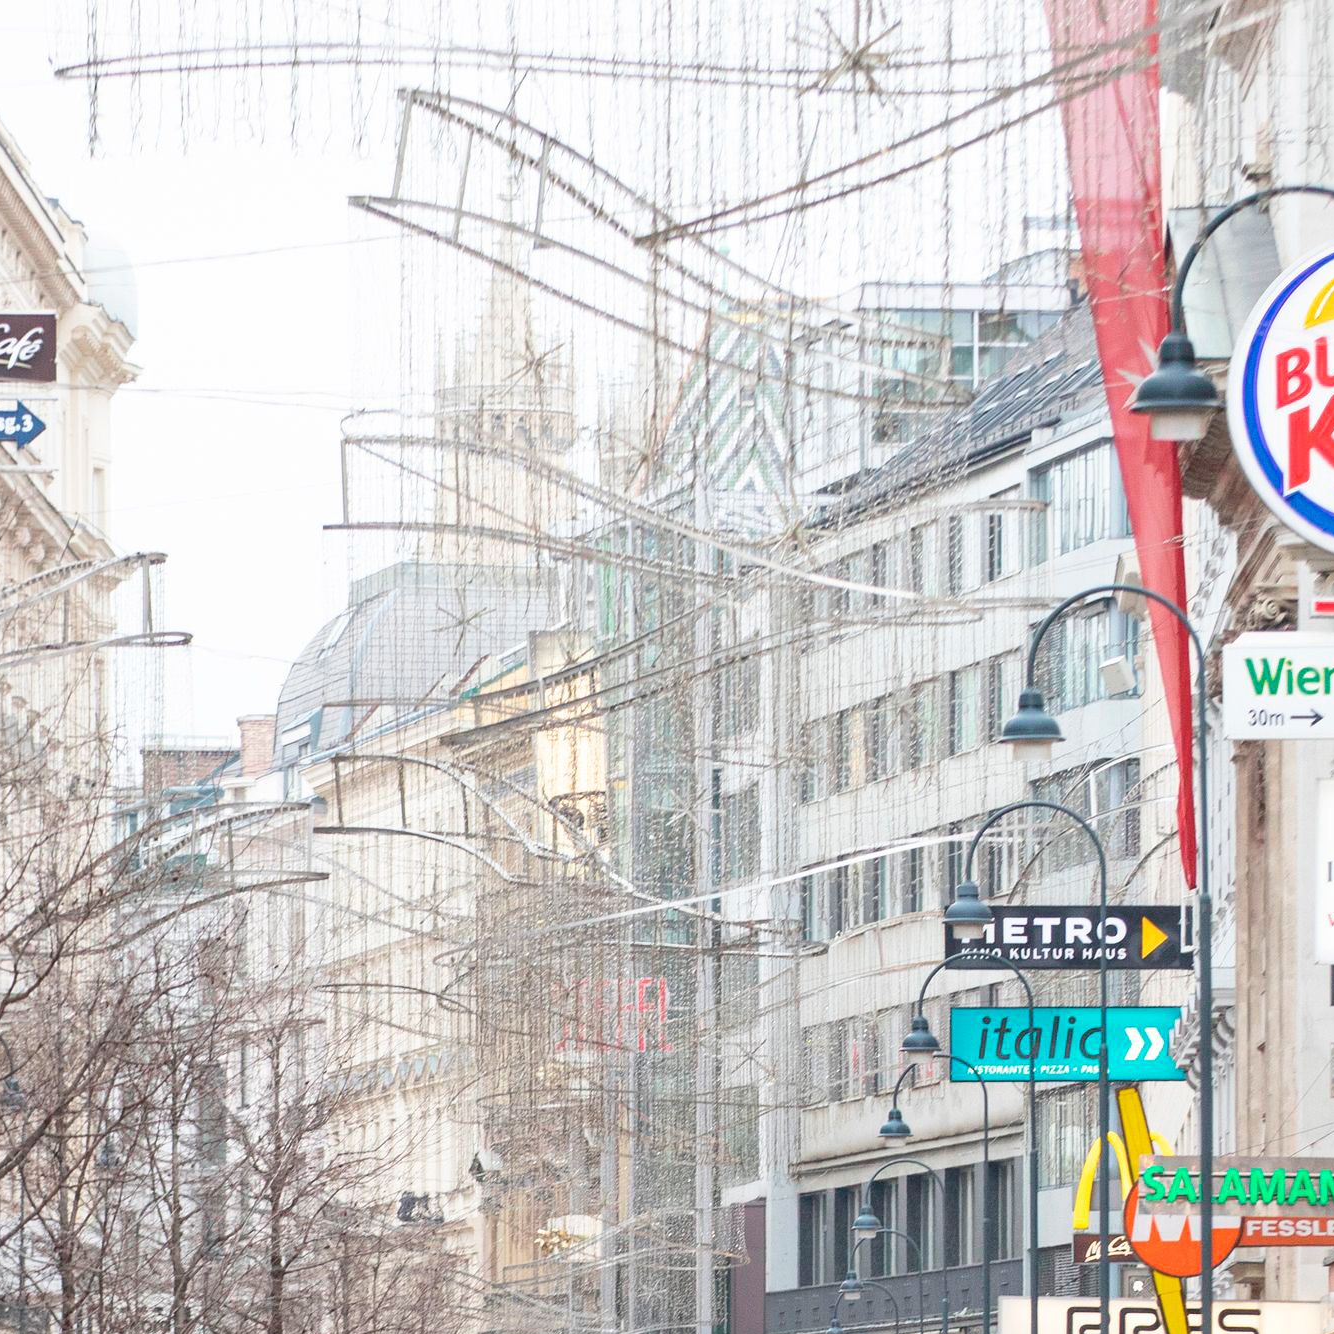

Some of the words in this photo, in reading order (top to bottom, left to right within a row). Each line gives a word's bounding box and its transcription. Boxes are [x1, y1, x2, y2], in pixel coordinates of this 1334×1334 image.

[1248, 709, 1284, 727] 30m
[1010, 947, 1076, 960] KULTUR
[1083, 947, 1127, 960] HAUS
[1040, 1065, 1070, 1074] PIZZA
